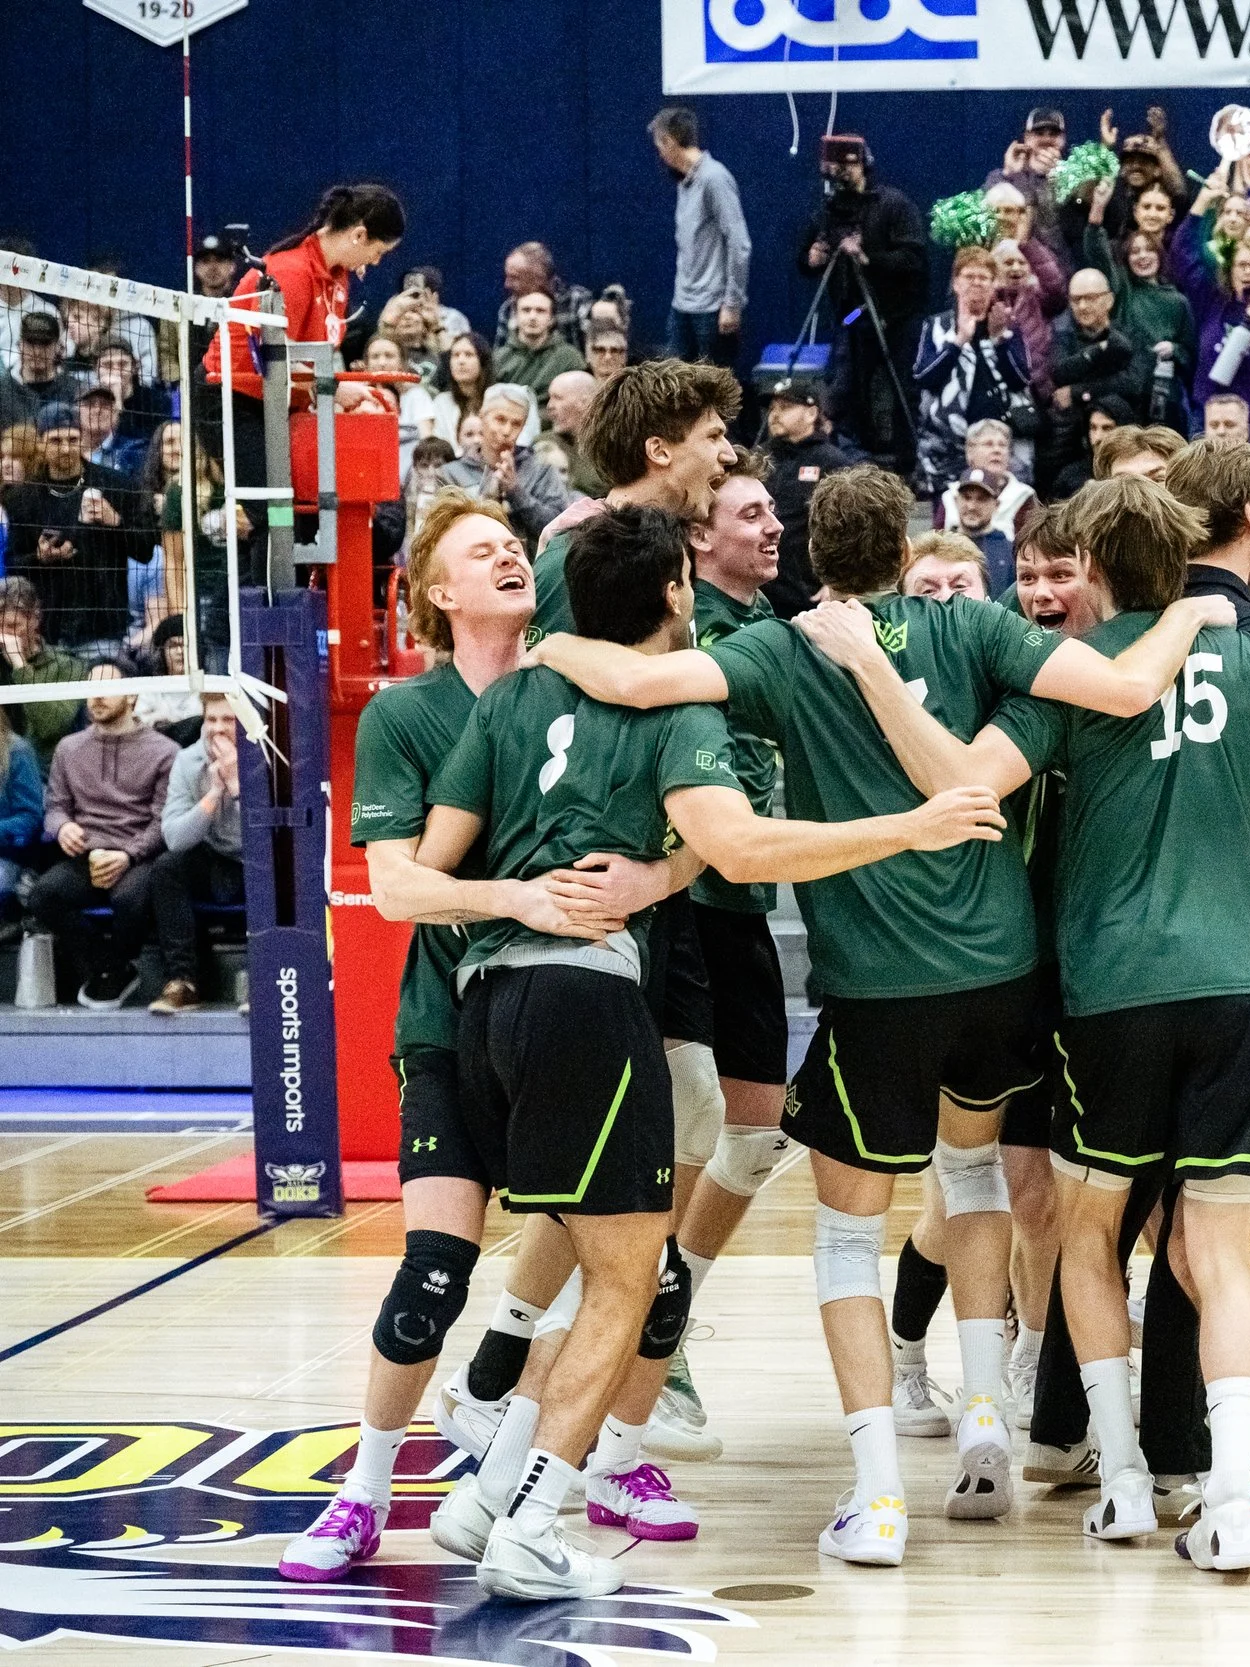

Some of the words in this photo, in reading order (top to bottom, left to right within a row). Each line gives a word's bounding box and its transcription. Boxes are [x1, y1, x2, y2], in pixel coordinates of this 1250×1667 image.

[137, 2, 195, 19] 19-20
[1150, 651, 1229, 761] 15
[361, 809, 393, 820] Polytechnic
[276, 967, 302, 1041] sports
[279, 1043, 306, 1133] imports
[273, 1185, 319, 1202] OOKS
